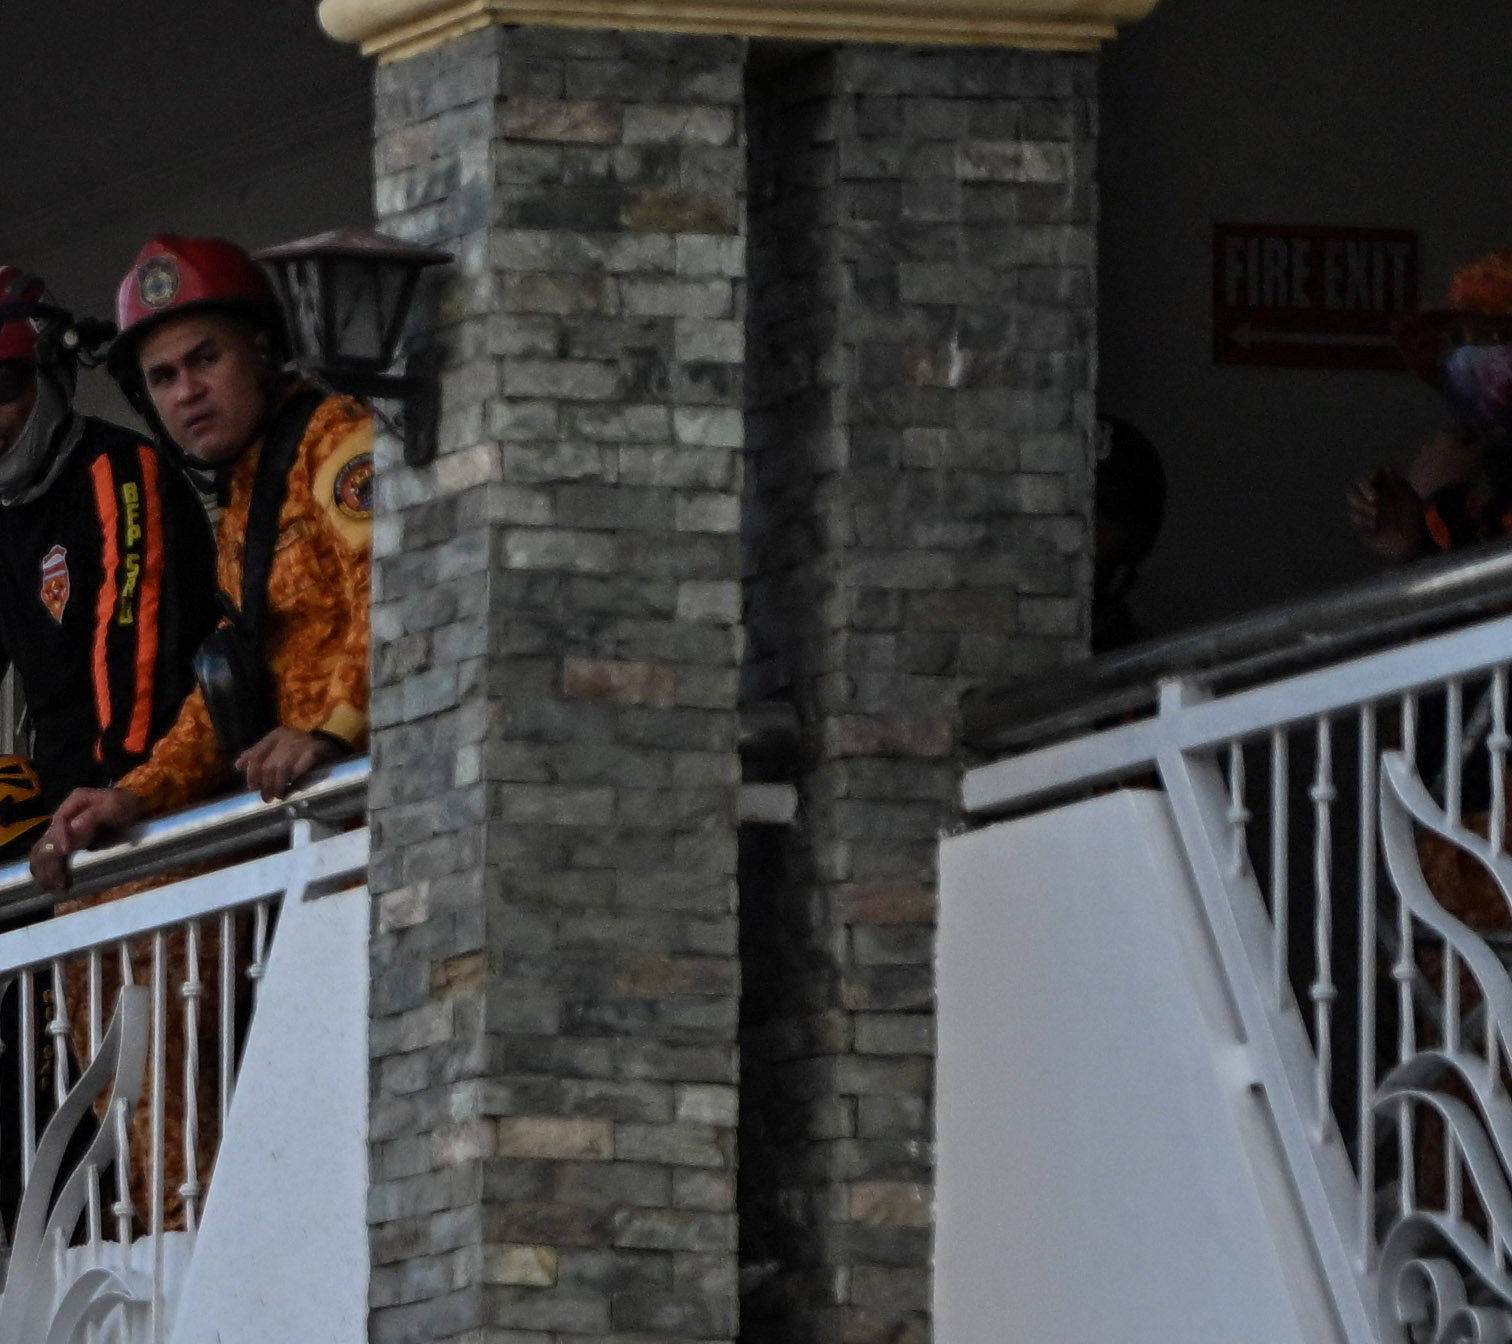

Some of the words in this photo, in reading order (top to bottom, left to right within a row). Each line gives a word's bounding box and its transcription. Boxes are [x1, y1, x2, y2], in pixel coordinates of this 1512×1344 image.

[1225, 236, 1312, 308] FIRE
[1324, 239, 1412, 312] EXIT
[122, 482, 141, 548] BFP
